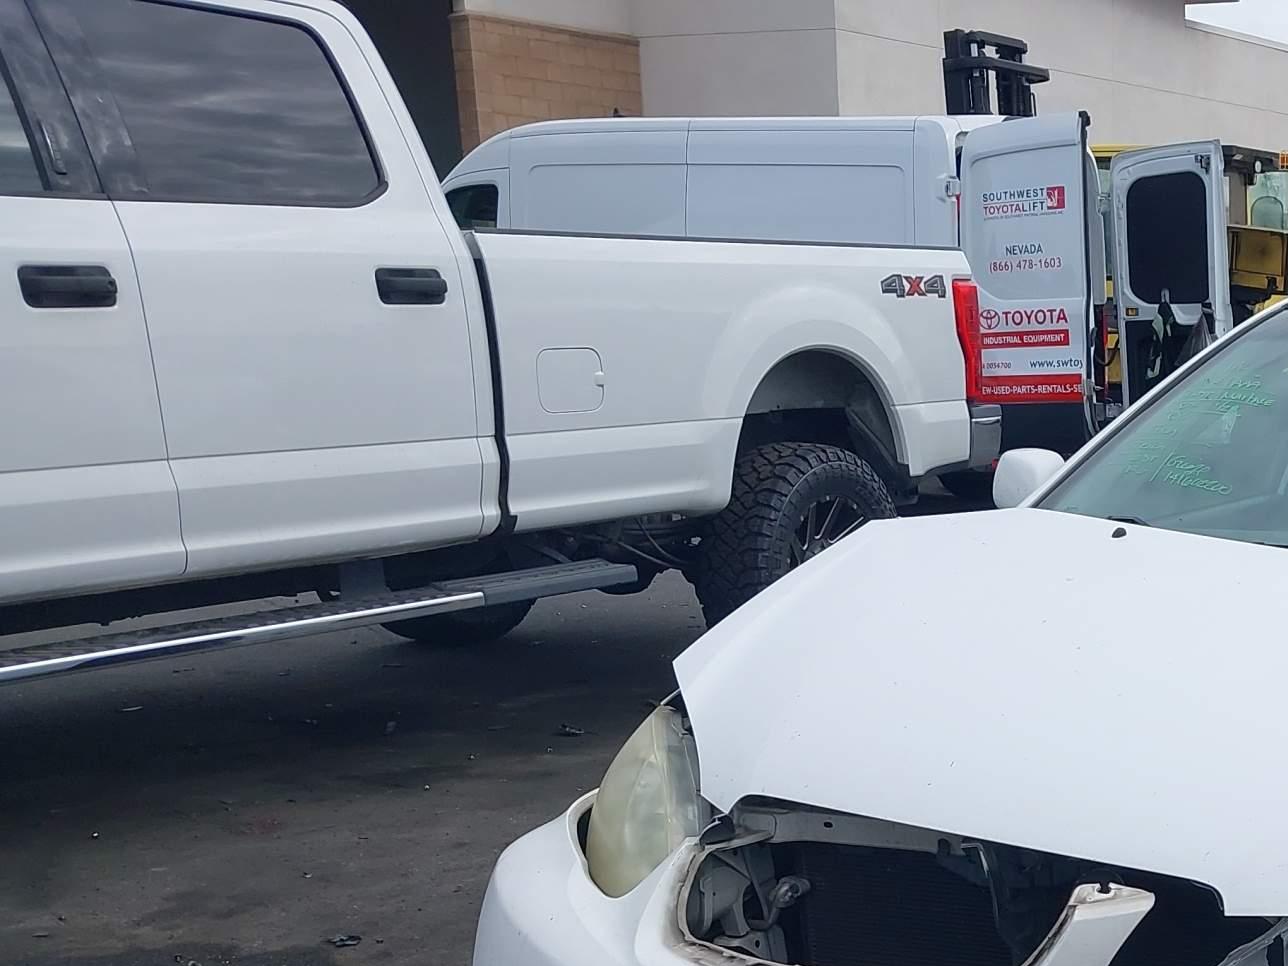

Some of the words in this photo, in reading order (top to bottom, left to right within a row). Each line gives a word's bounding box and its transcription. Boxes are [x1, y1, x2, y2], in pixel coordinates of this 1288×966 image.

[982, 187, 1046, 203] SOUTHWEST
[983, 201, 1046, 216] TOYOTALIFT
[1005, 243, 1044, 256] NEVADA
[989, 260, 1014, 274] (866)
[1016, 257, 1063, 271] 478-1603
[1002, 308, 1069, 327] TOYOTA
[983, 335, 1022, 345] INDUSTRIAL
[1023, 333, 1066, 344] EQUIPMENT
